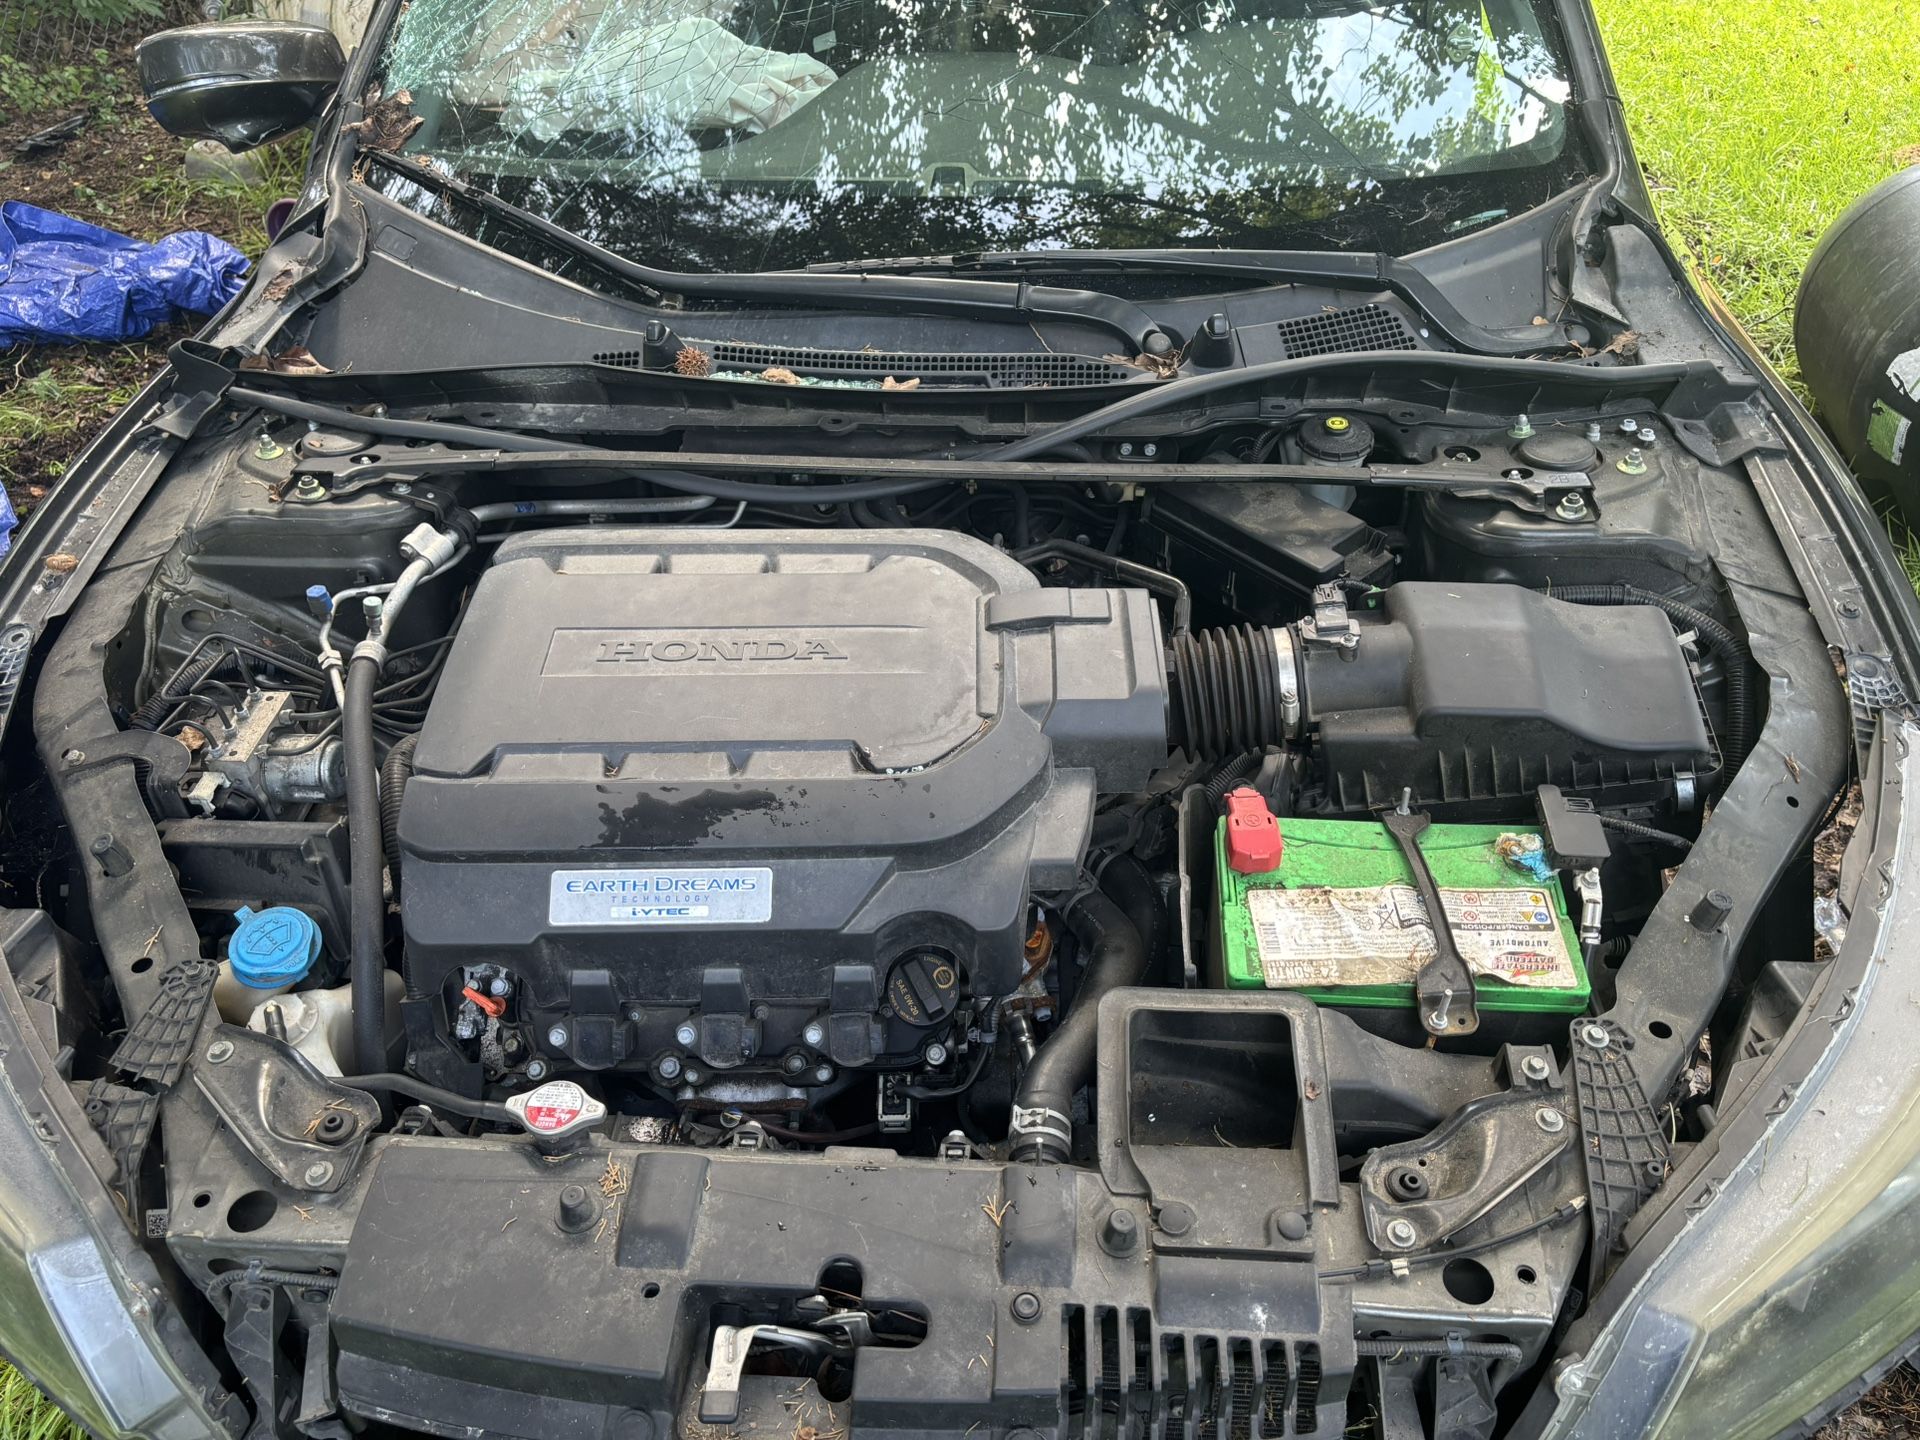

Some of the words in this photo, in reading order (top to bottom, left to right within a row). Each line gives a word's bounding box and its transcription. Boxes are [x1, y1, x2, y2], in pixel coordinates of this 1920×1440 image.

[596, 638, 848, 663] HONDA
[566, 879, 648, 893] EARTH
[655, 877, 756, 893] DREAMS
[611, 895, 711, 904] TECHNOLOGY
[1460, 923, 1530, 931] DANGER/POISON
[1489, 938, 1549, 947] AUTOMOTIVE
[896, 980, 908, 993] SAE
[903, 994, 919, 1016] 0W-20
